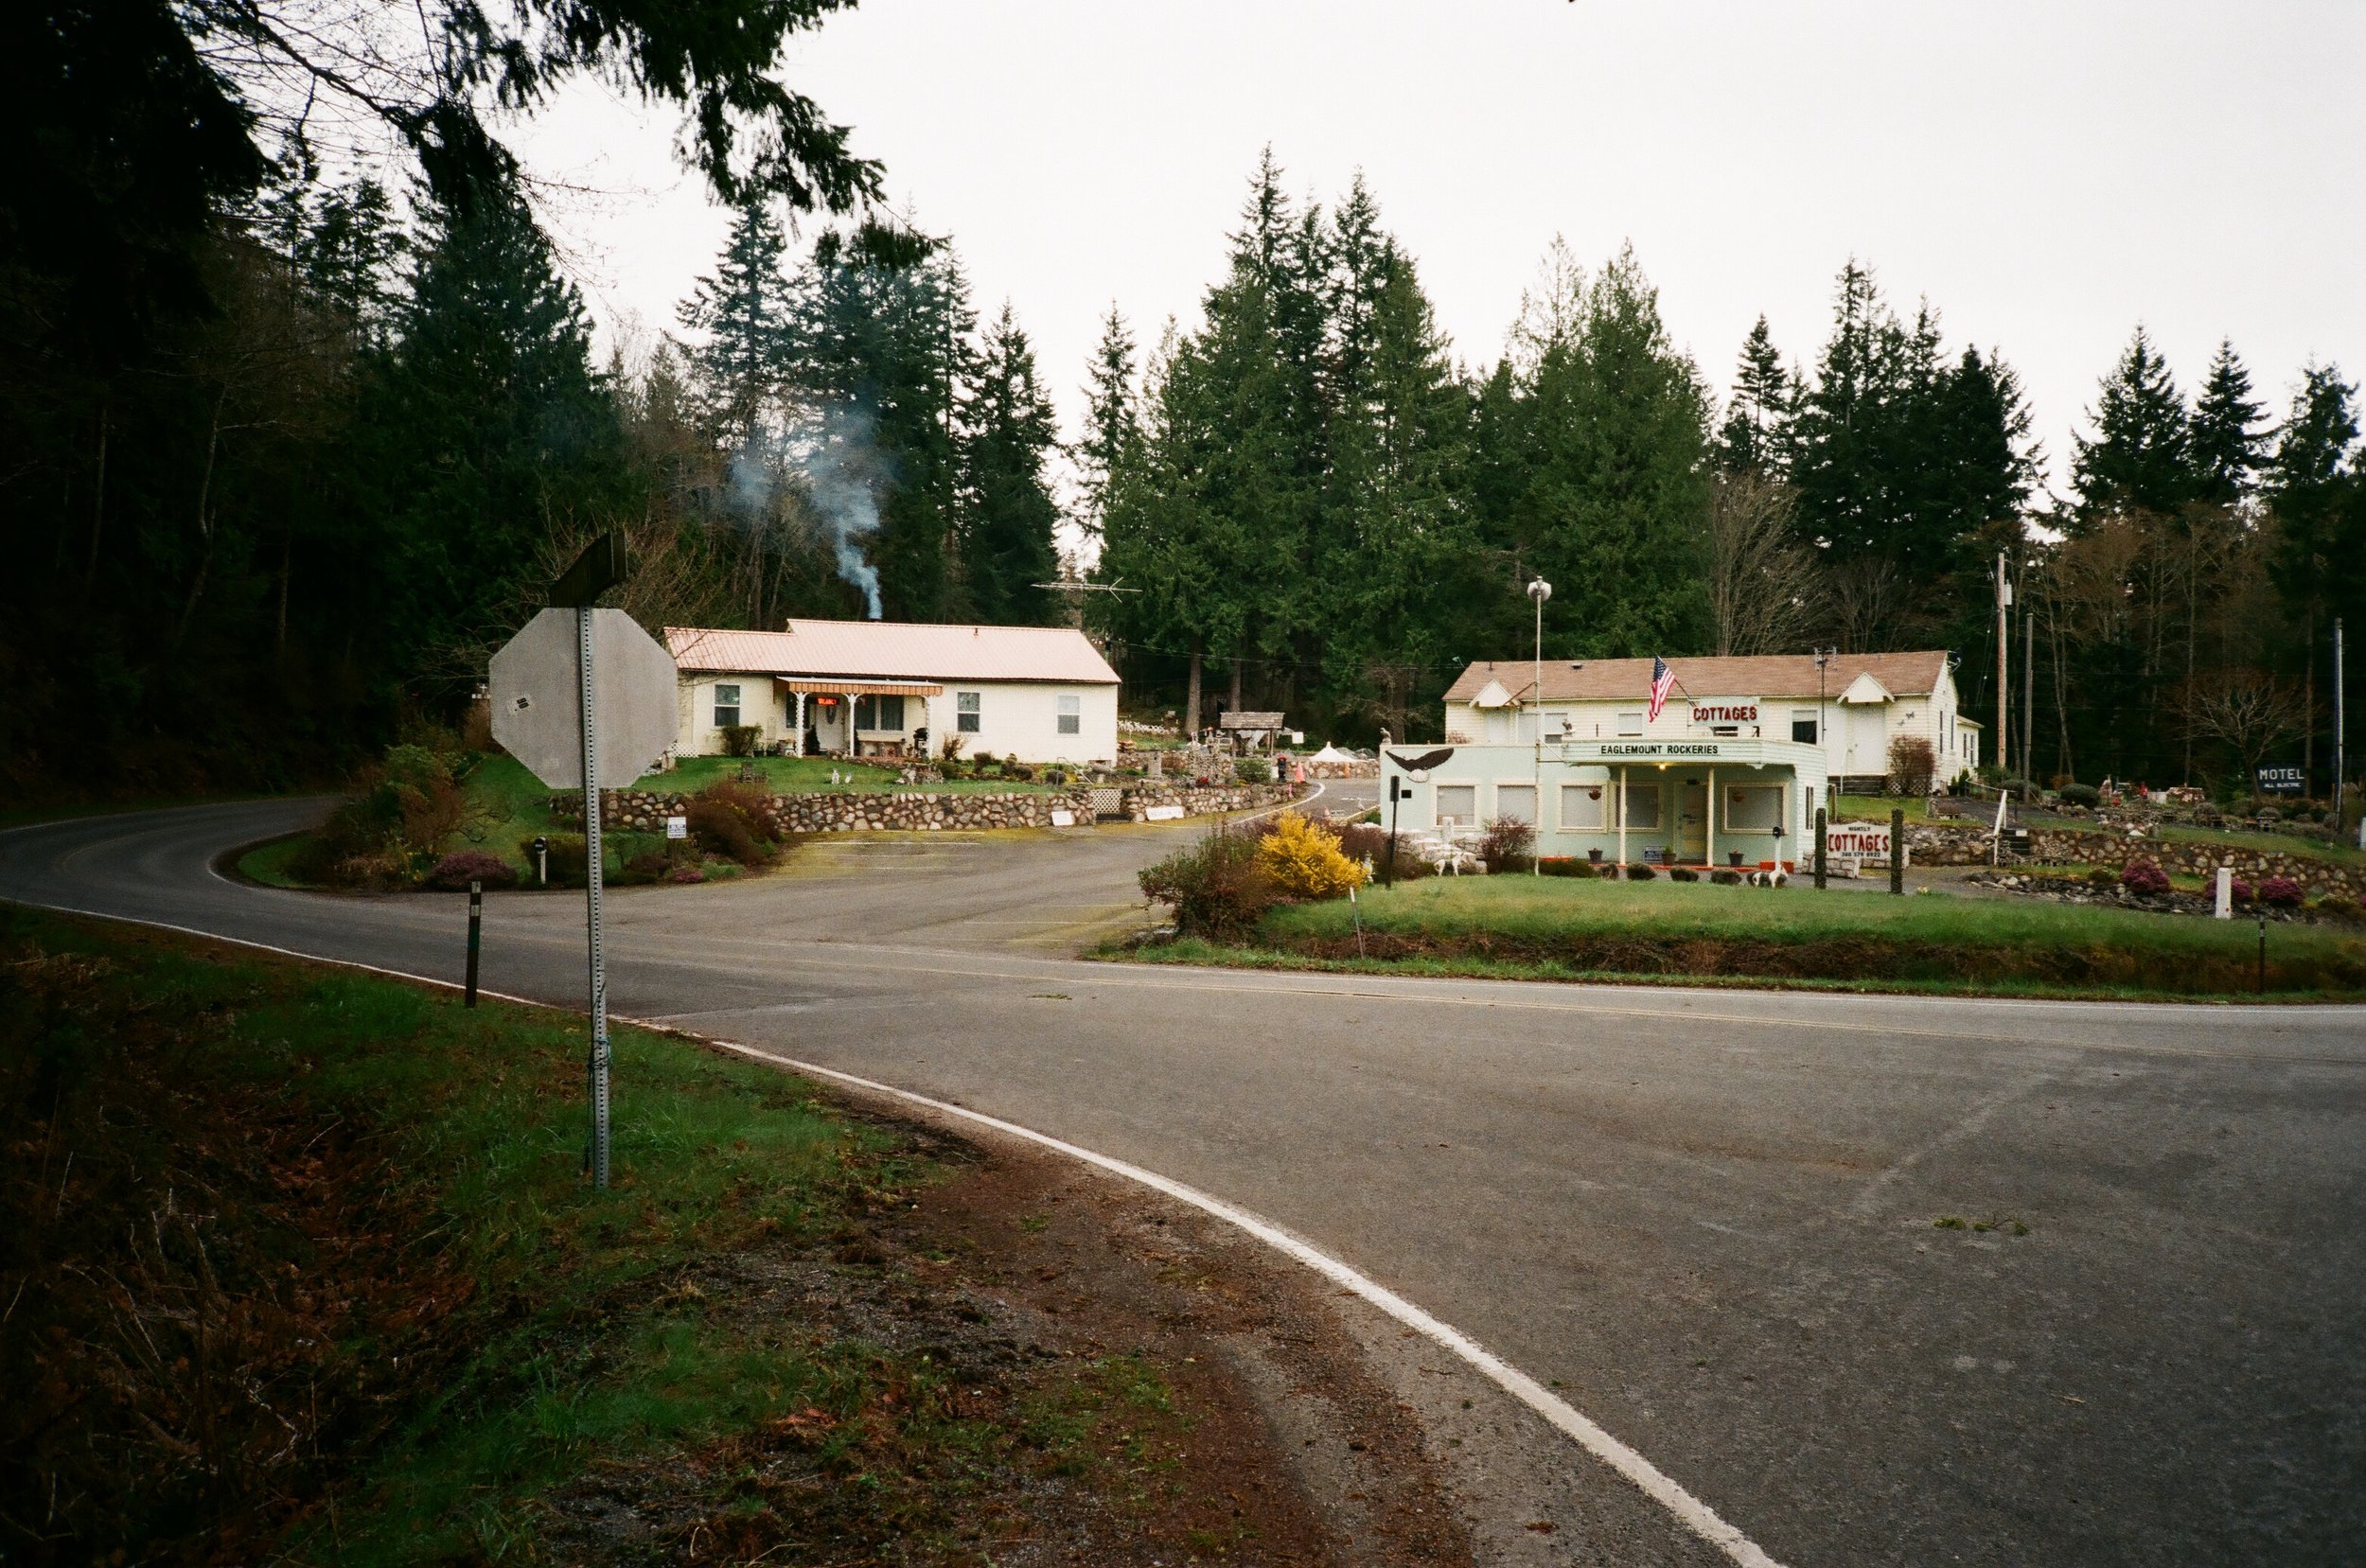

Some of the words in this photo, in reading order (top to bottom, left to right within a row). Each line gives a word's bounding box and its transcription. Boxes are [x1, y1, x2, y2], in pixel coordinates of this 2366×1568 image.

[1693, 706, 1757, 721] COTTAGES
[1600, 745, 1663, 754] EAGLEMOUNT
[1667, 745, 1719, 754] ROCKERIES
[2259, 768, 2305, 781] MOTEL
[1827, 834, 1889, 852] COTTAGES
